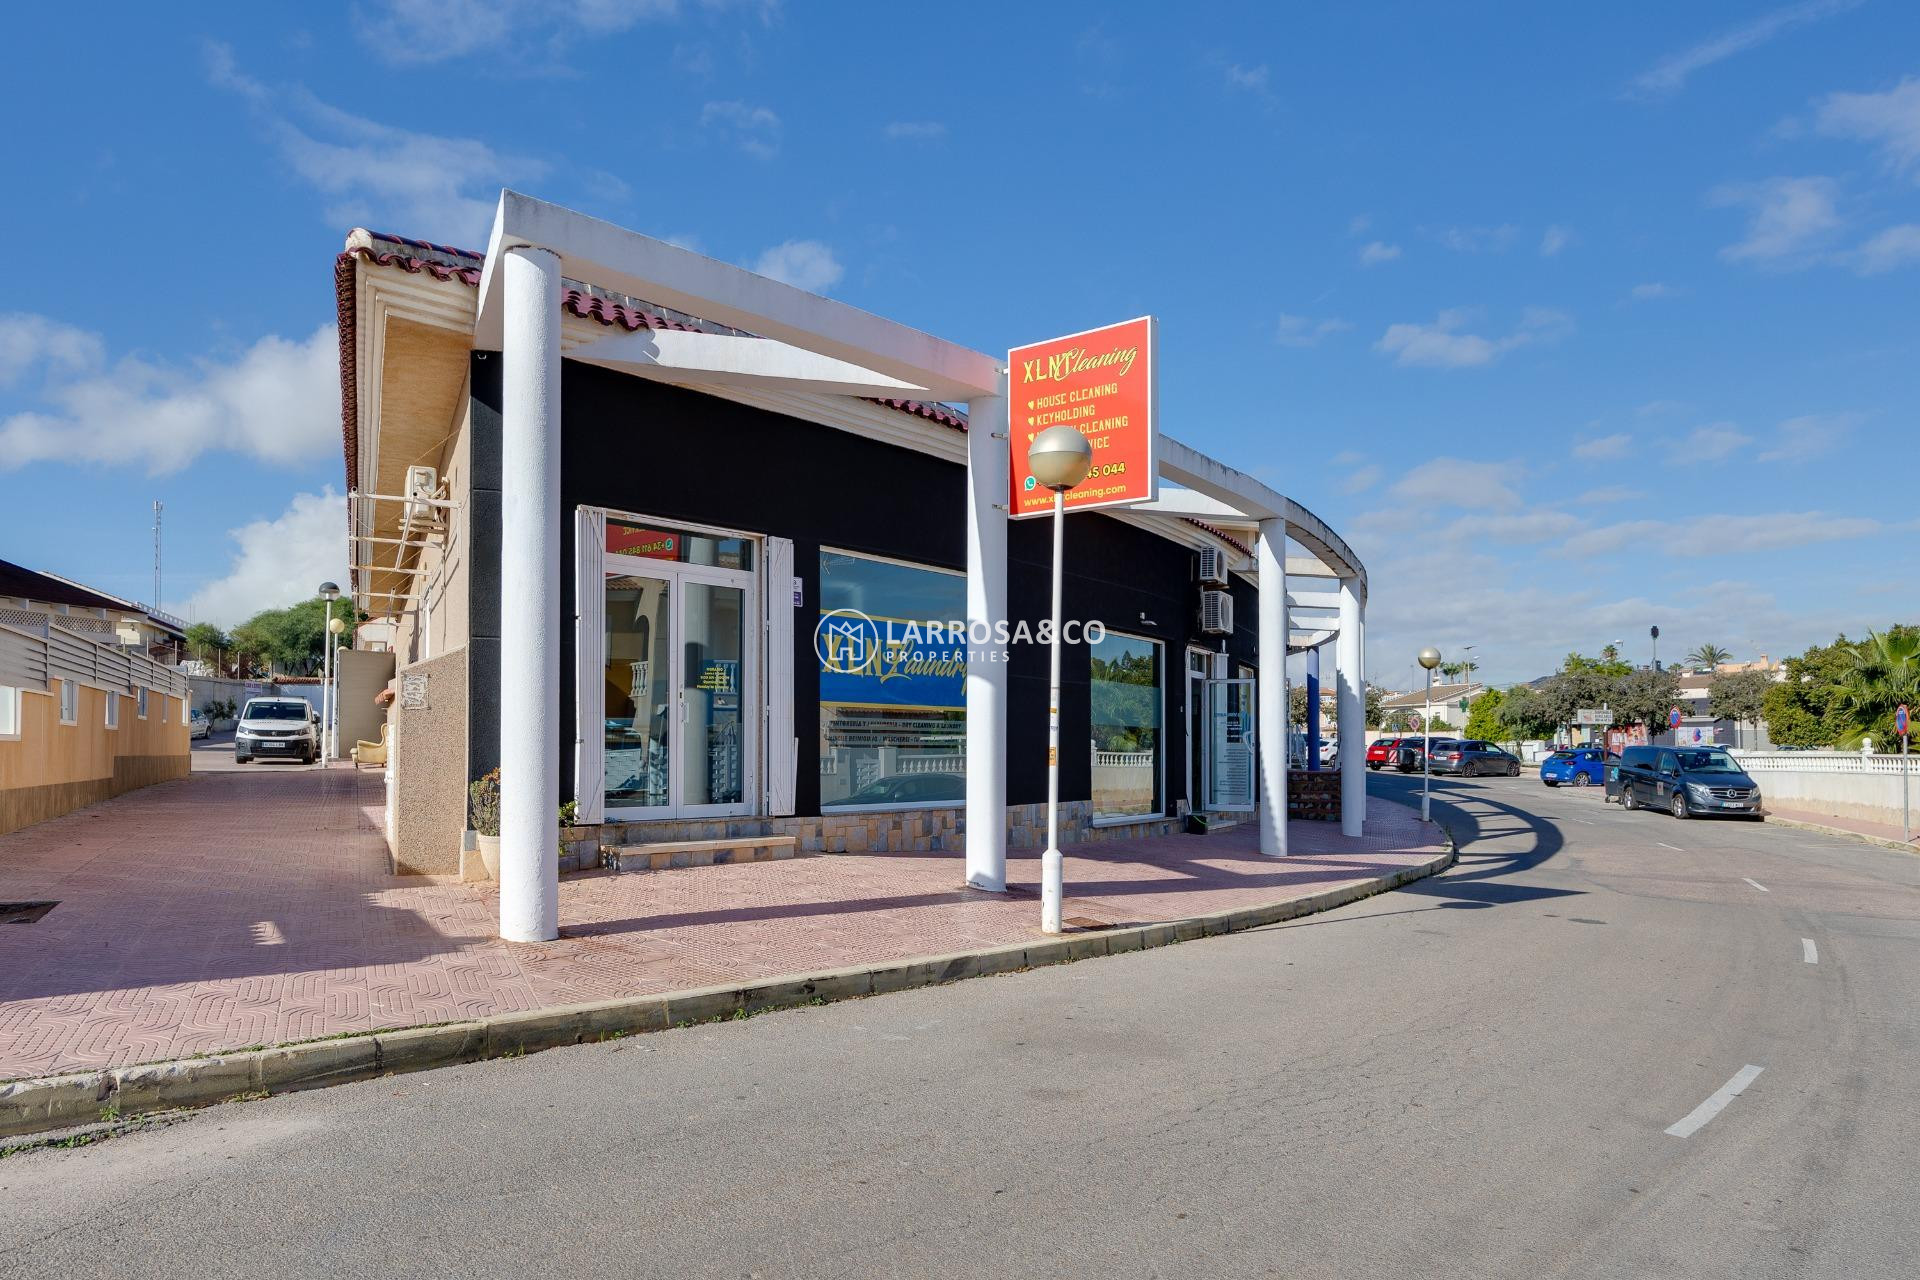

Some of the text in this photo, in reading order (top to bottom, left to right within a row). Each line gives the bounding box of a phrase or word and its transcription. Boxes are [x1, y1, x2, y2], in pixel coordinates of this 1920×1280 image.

[1023, 347, 1137, 383] XLNT Cleaning
[1036, 383, 1118, 410] HOUSE CLEANING
[1036, 405, 1096, 426] KEYHOLDING
[1079, 415, 1129, 435] CLEANING
[1102, 462, 1126, 477] 044
